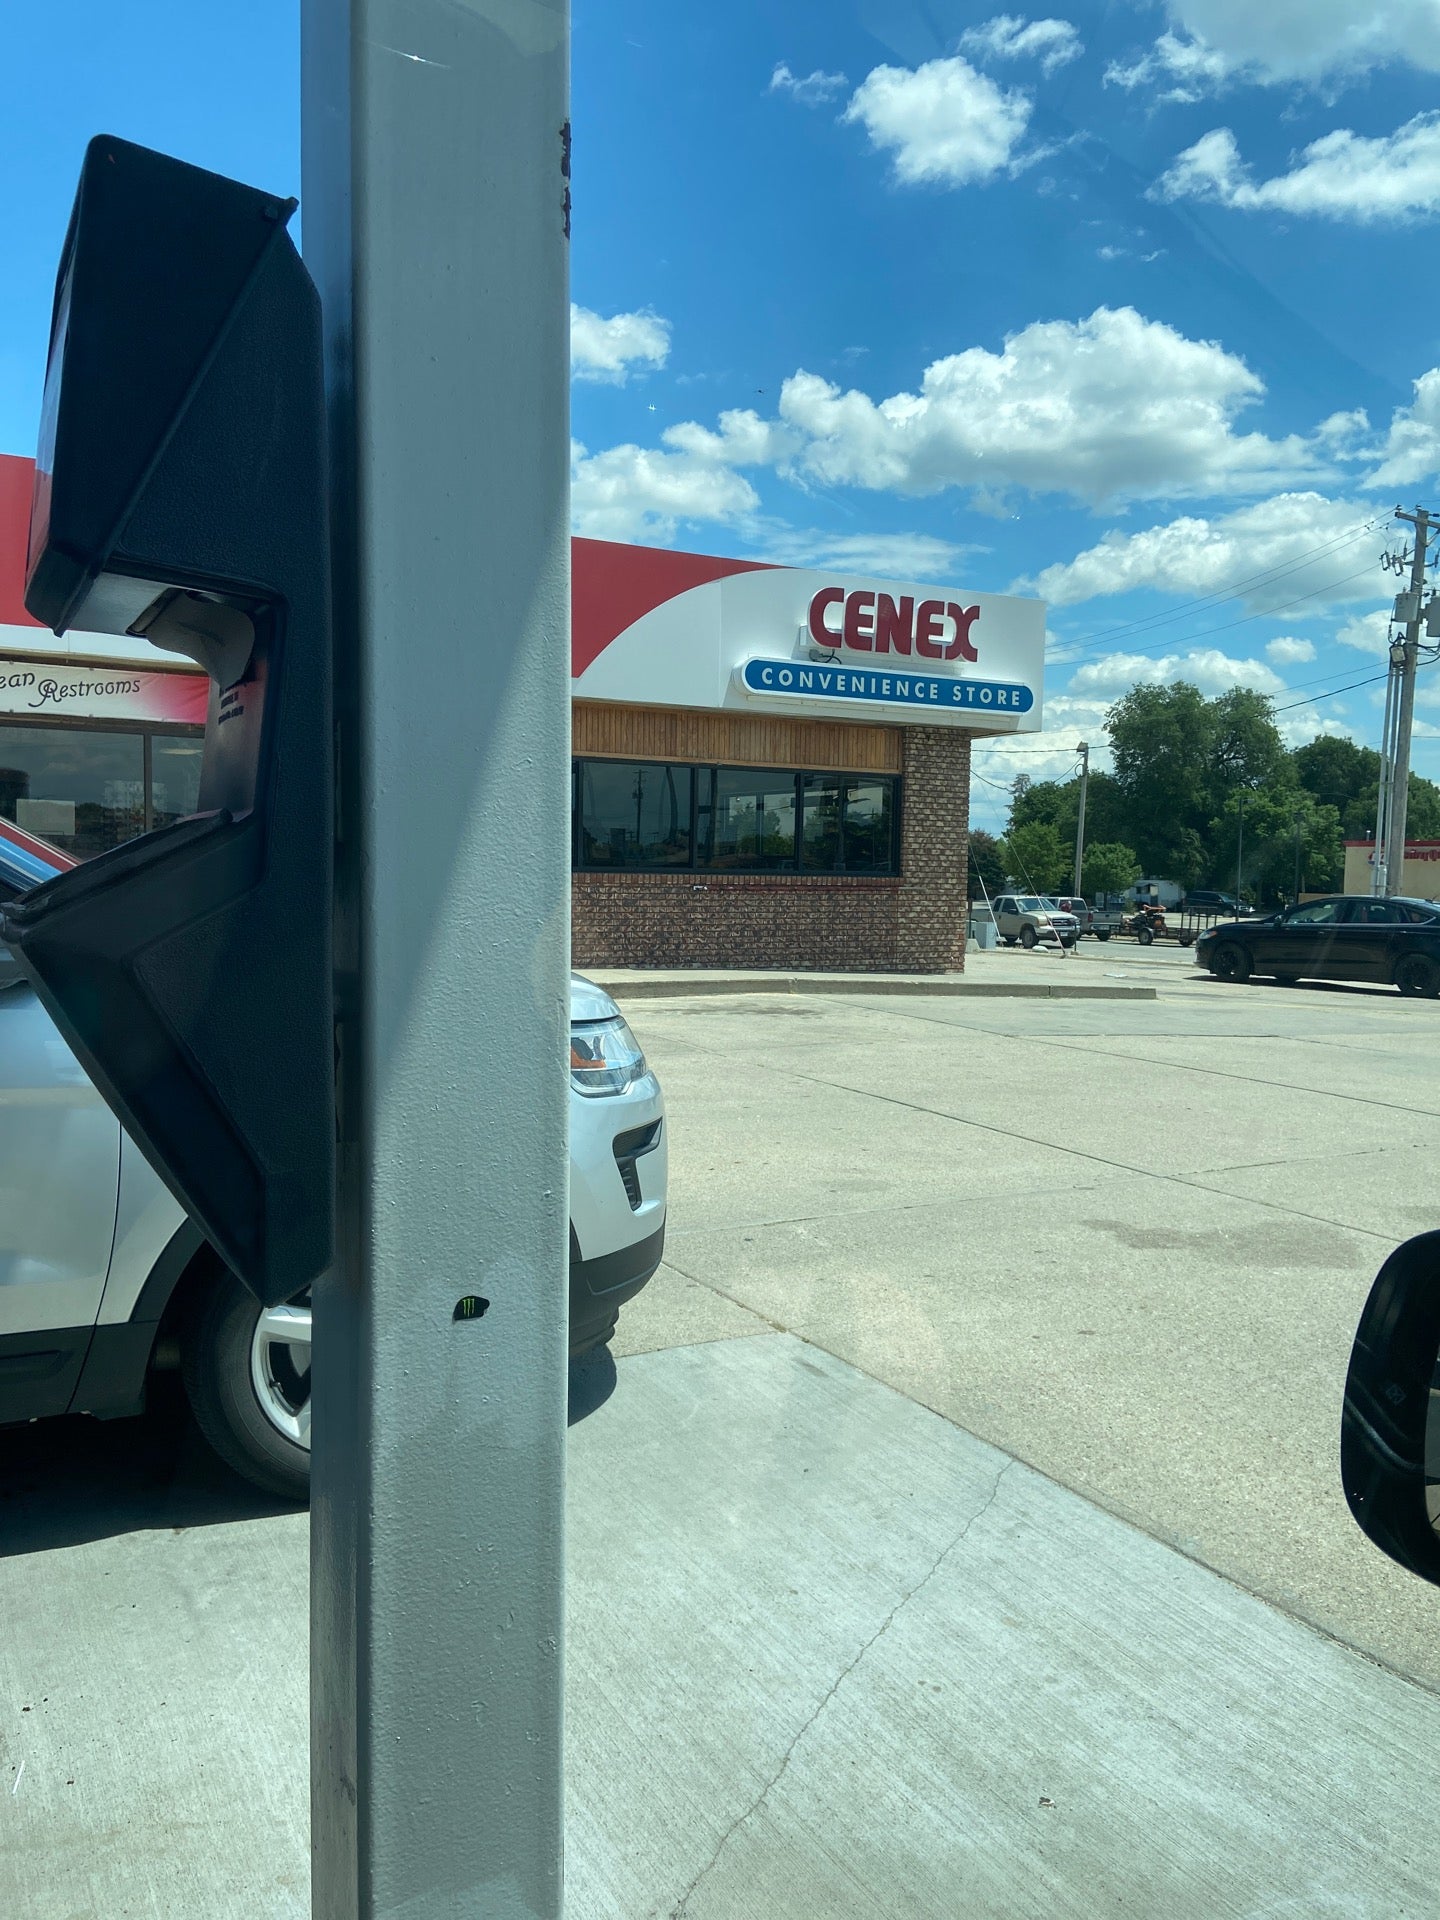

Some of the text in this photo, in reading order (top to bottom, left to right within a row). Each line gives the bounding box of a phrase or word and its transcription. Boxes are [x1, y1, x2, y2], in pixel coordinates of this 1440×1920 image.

[809, 587, 980, 662] CENEX
[28, 679, 141, 708] Restrooms
[761, 667, 1020, 706] CONVENIENCE STORE
